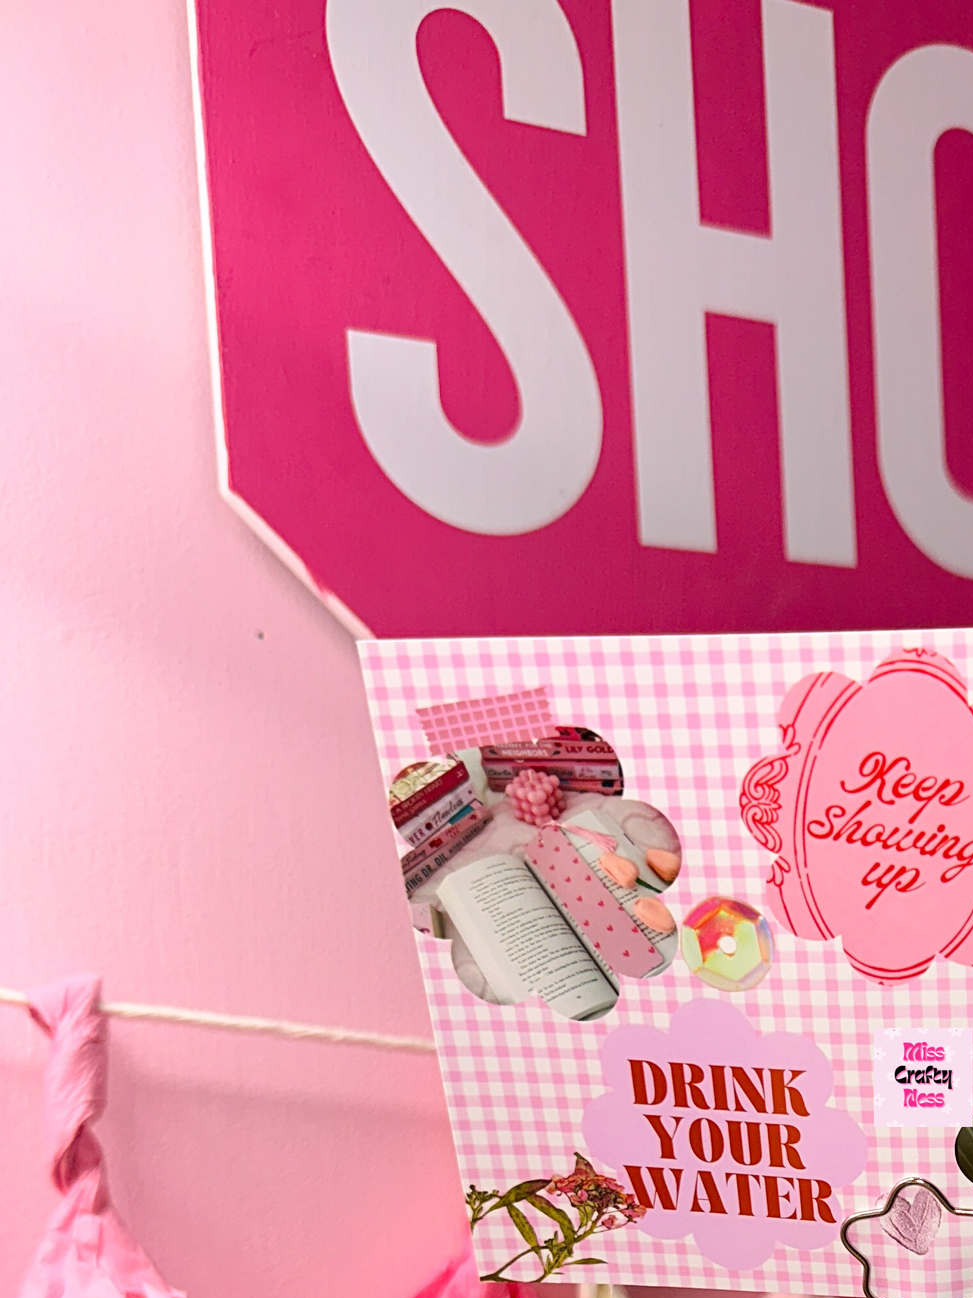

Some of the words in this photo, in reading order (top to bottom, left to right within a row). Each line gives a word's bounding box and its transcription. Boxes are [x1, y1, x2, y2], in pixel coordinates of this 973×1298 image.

[841, 751, 971, 824] Keep
[861, 862, 927, 909] up
[628, 1058, 811, 1117] DRINK
[643, 1114, 807, 1170] YOUR
[623, 1165, 837, 1223] WATER
